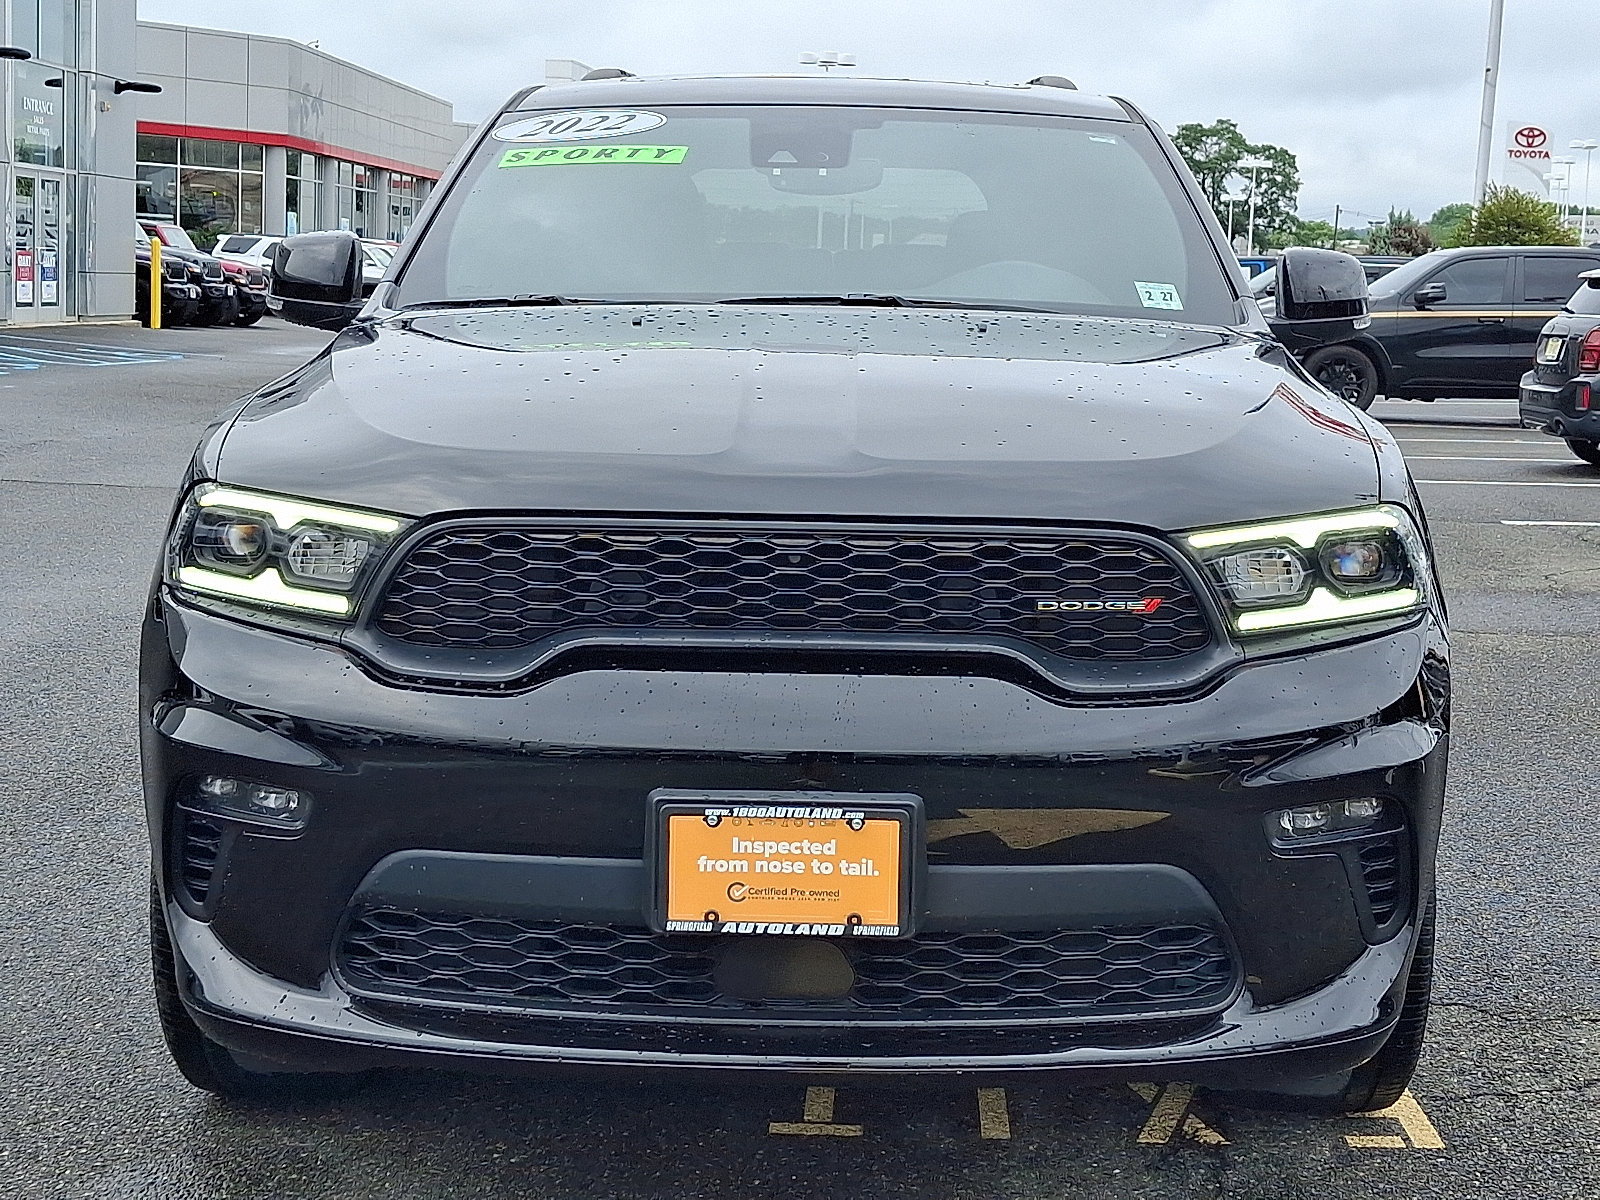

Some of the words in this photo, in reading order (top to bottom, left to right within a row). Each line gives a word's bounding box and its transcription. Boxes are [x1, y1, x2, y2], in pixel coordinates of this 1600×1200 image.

[23, 96, 54, 115] ENTRANCE
[516, 114, 638, 138] 2022
[505, 147, 677, 163] SPORTY
[1507, 149, 1550, 159] TOYOTA
[1159, 291, 1173, 302] 27
[1037, 601, 1146, 611] DODGE
[732, 836, 836, 858] Inspected
[697, 855, 749, 873] from
[755, 859, 806, 874] nose
[811, 858, 834, 875] to
[839, 858, 880, 877] tail.
[747, 887, 788, 896] Certified
[666, 920, 713, 932] SPRINGFIELD
[721, 922, 846, 936] AUTOLAND
[852, 924, 900, 937] SPRINGFIELD
